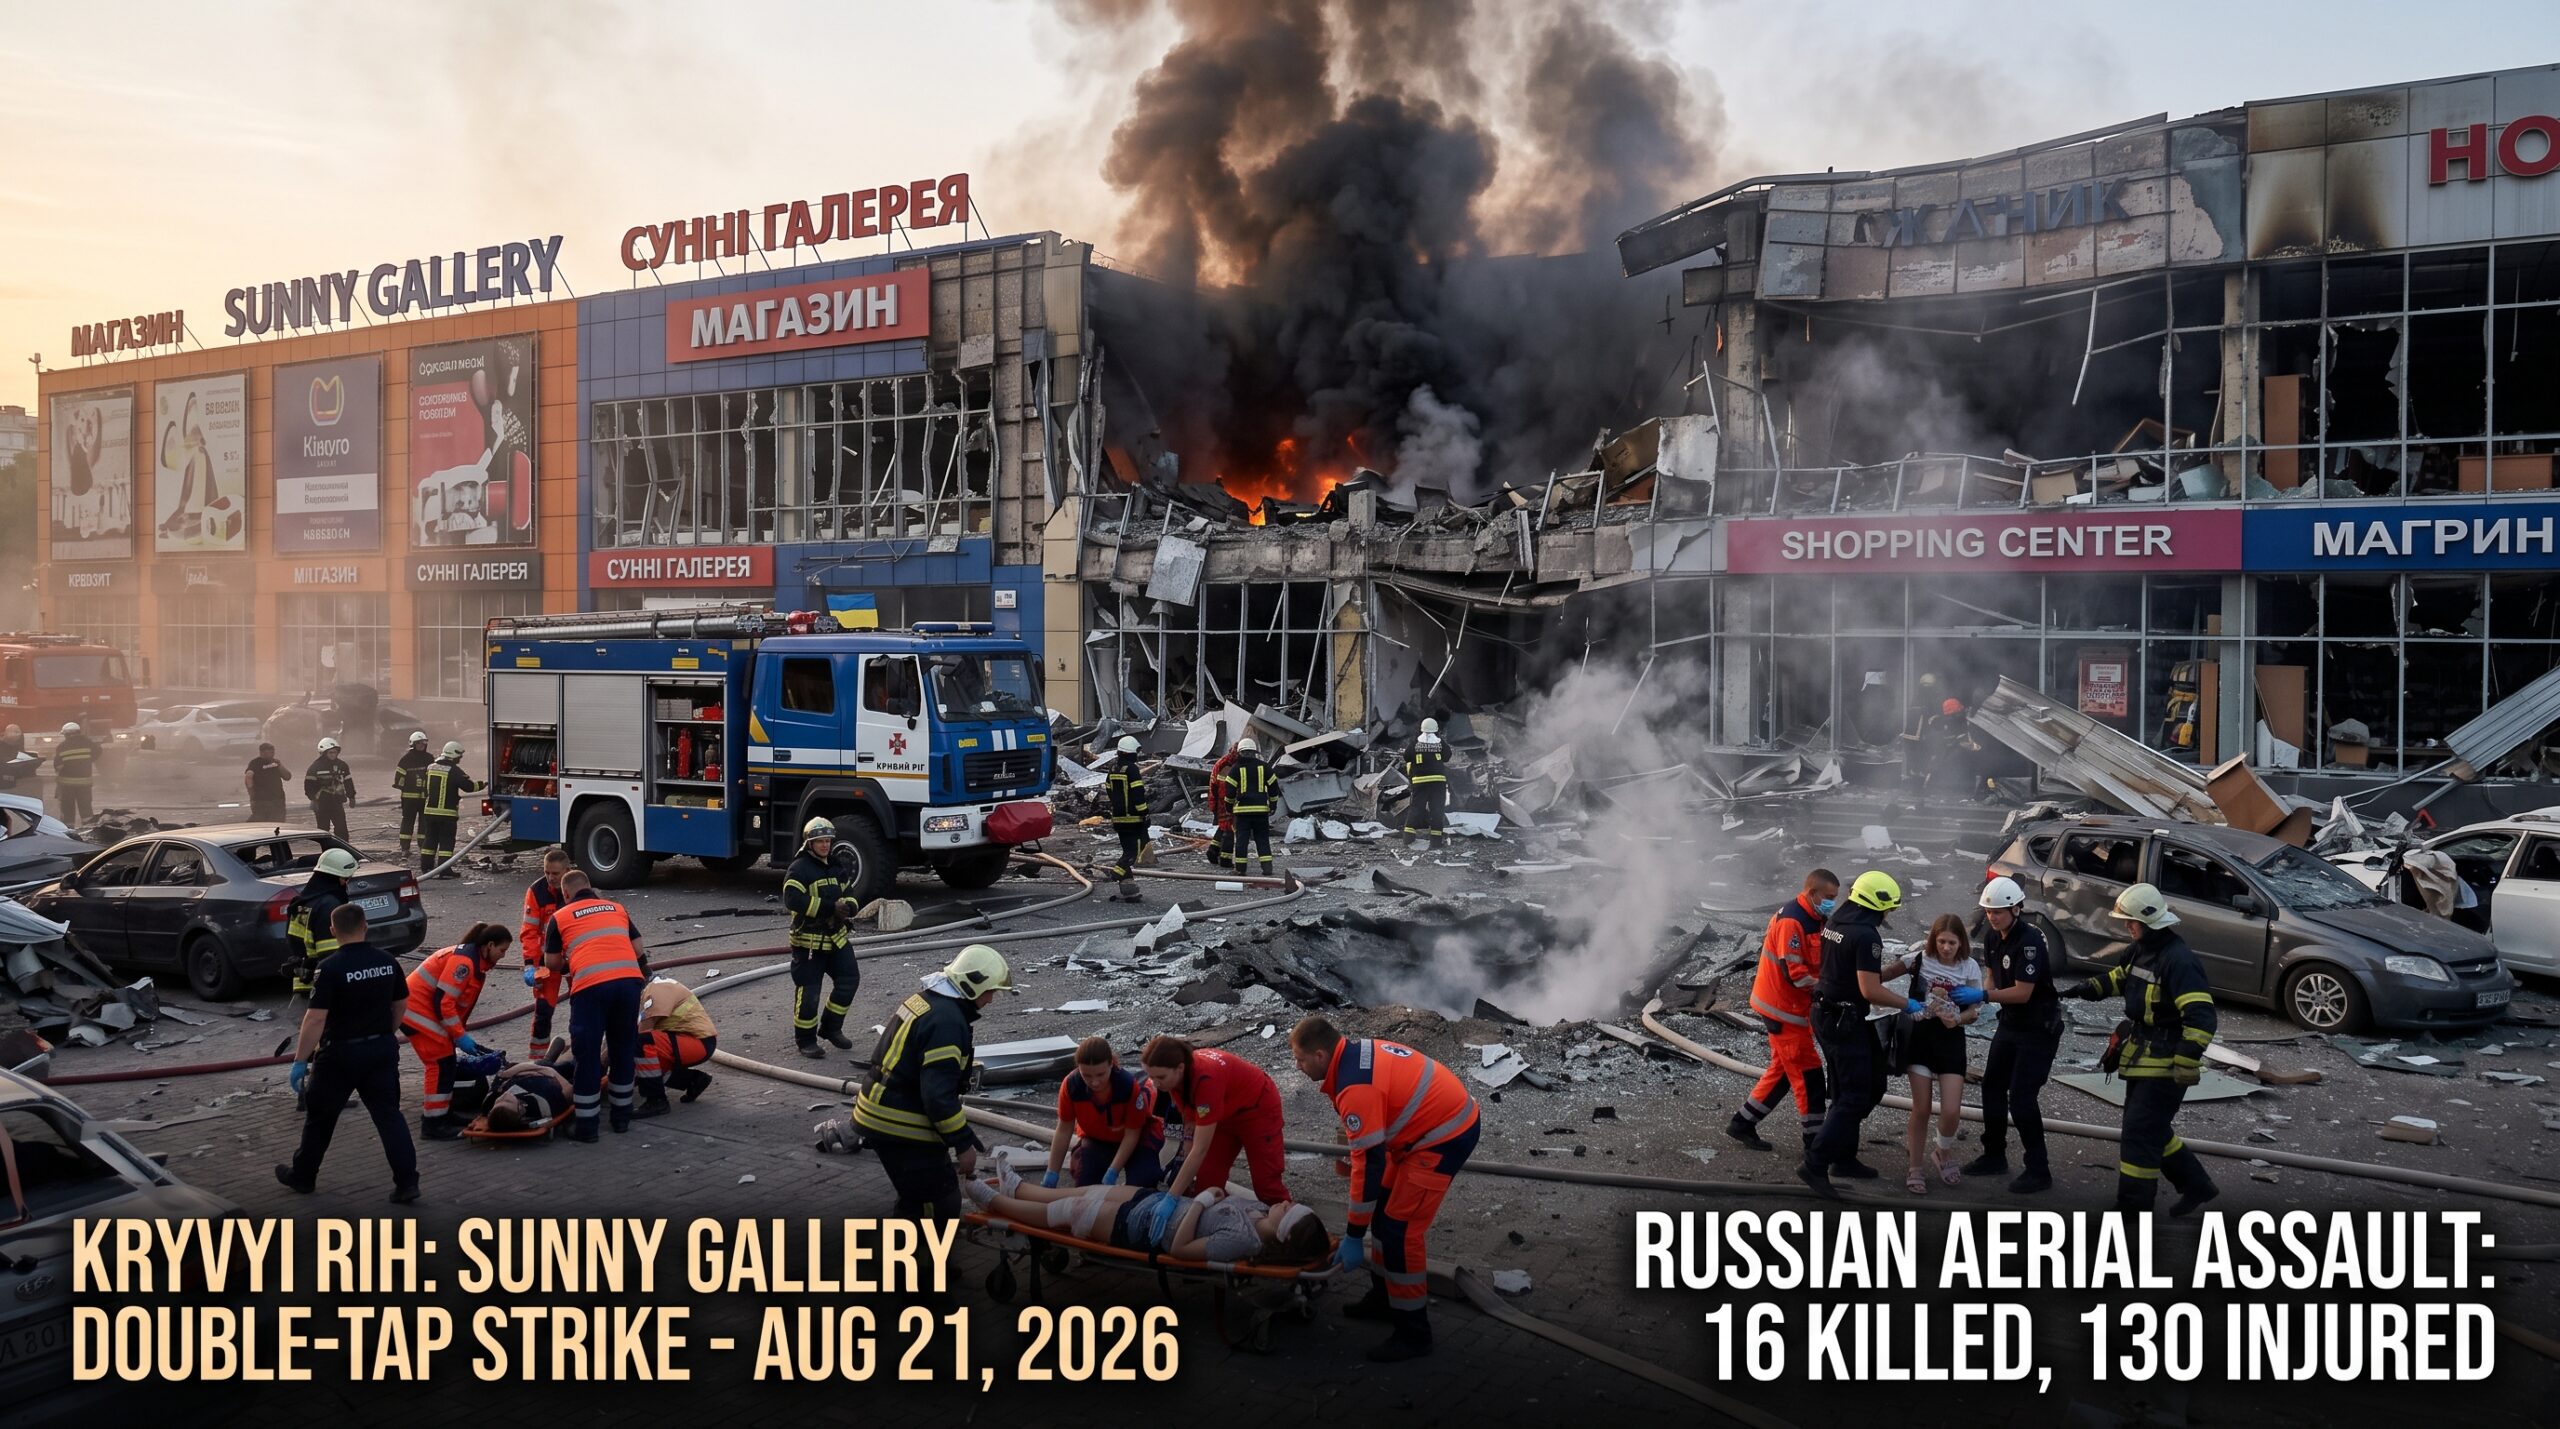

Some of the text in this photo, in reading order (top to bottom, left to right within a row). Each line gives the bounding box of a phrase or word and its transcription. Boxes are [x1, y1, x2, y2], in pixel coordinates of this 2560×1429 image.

[621, 173, 968, 271] СУННІ ГАЛЕРЕЯ
[224, 235, 563, 337] SUNNY GALLERY
[71, 309, 183, 357] МАГАЗИН
[691, 284, 897, 348] МАГАЗИН
[1781, 525, 2173, 560] SHOPPING CENTER
[2313, 517, 2553, 556] МАГРИН
[417, 562, 528, 582] СУННІ ГАЛЕРЕЯ
[607, 556, 750, 580] СУННІ ГАЛЕРЕЯ
